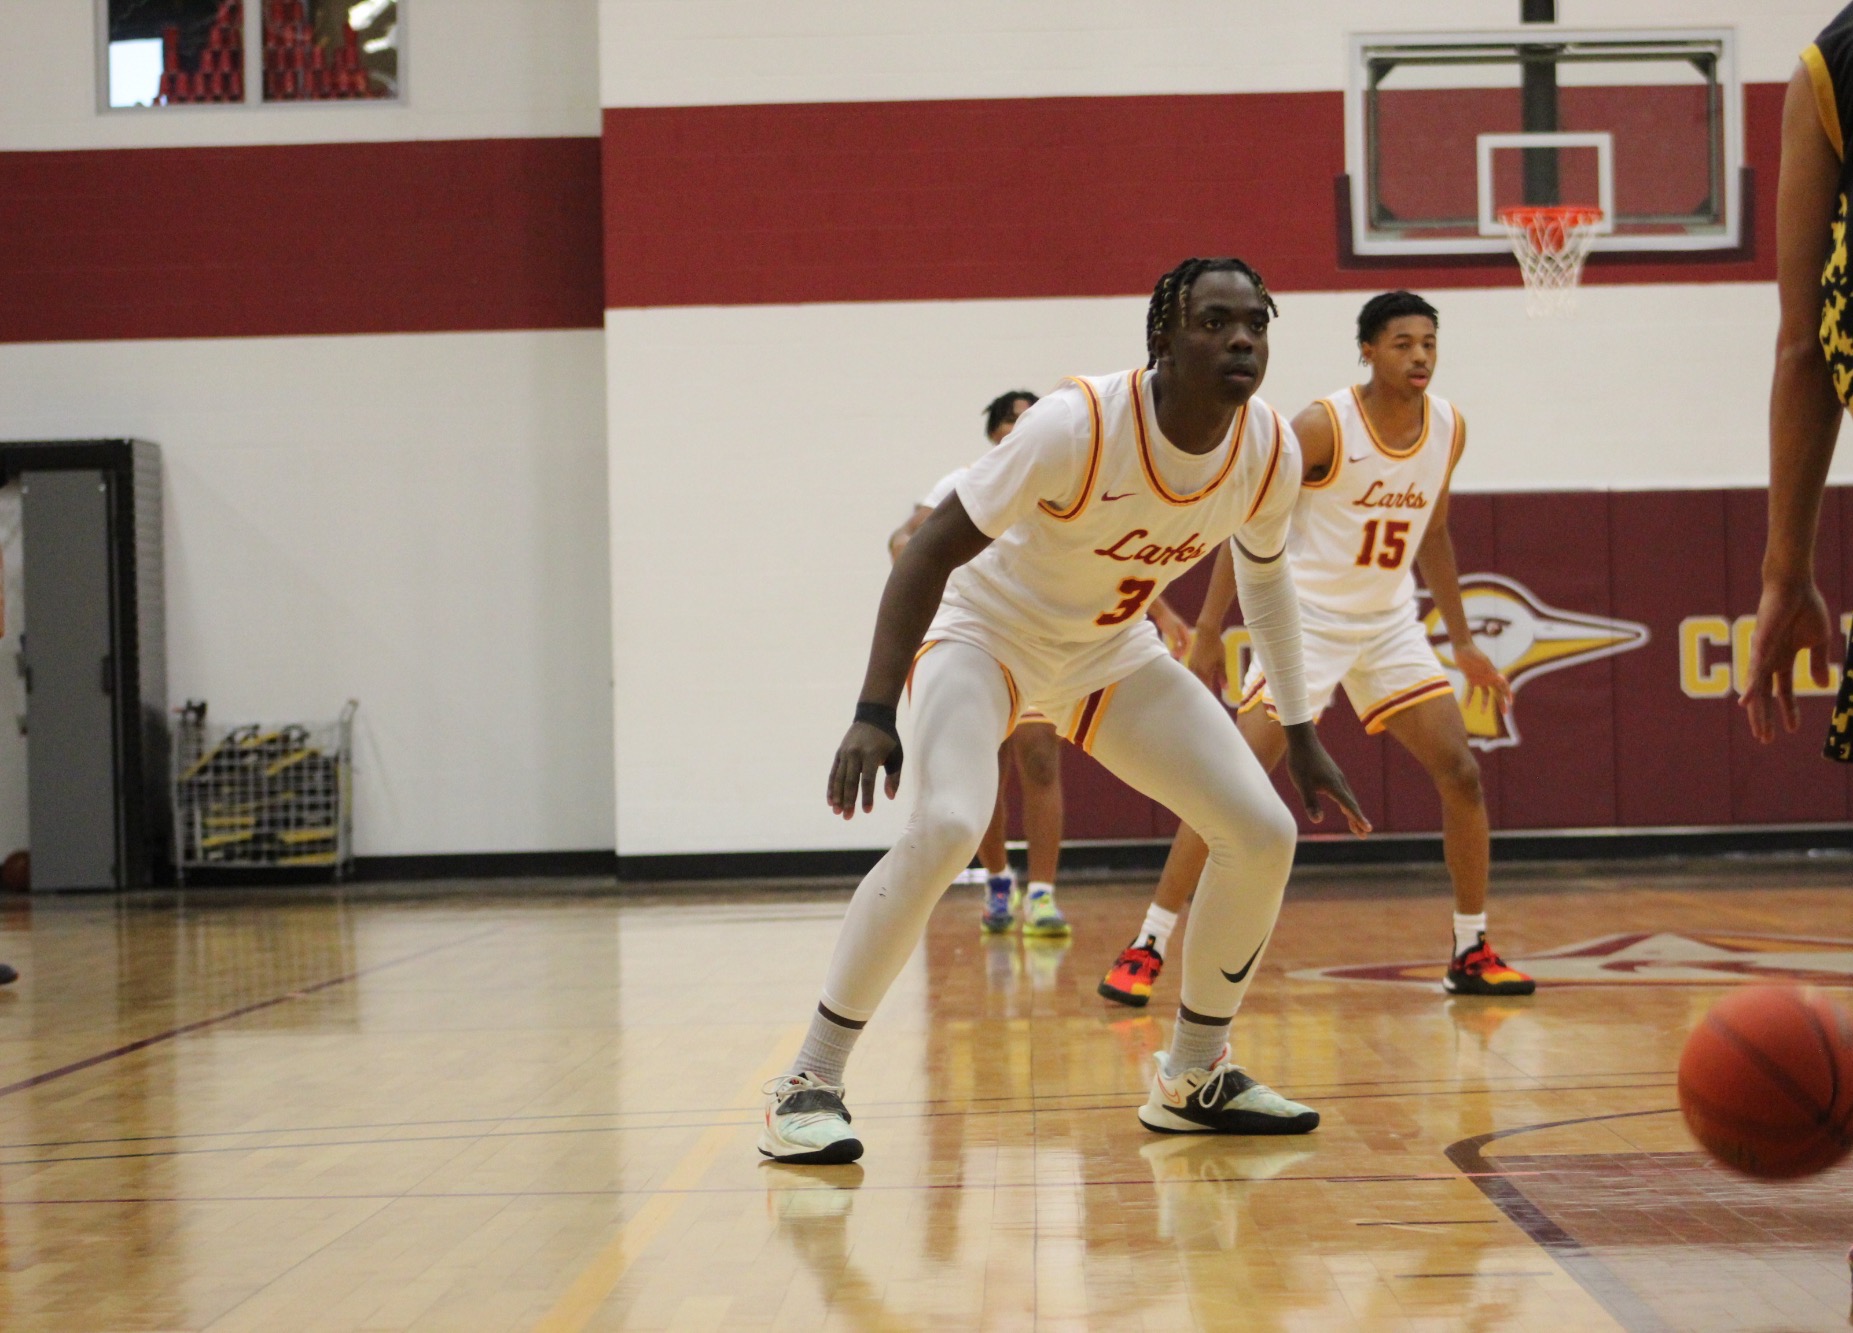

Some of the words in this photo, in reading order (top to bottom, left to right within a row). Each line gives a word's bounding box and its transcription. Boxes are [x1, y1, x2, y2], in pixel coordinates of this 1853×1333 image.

[1352, 480, 1427, 509] Larks
[1094, 529, 1206, 566] Larks
[1355, 518, 1411, 570] 15
[1094, 576, 1157, 627] 3
